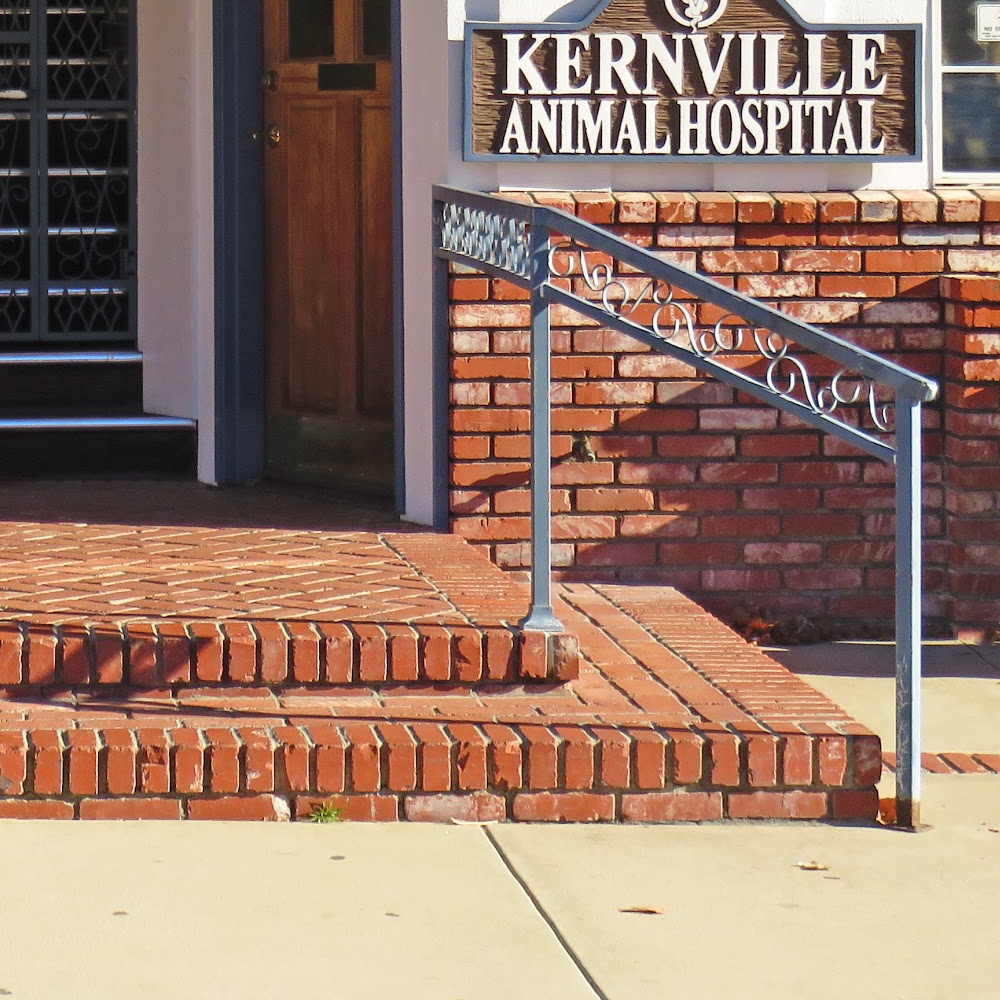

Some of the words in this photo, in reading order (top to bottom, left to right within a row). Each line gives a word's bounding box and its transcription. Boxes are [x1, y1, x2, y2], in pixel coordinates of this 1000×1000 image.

[501, 31, 887, 96] KERNVILLE
[499, 99, 671, 155] ANIMAL
[677, 98, 889, 156] HOSPITAL
